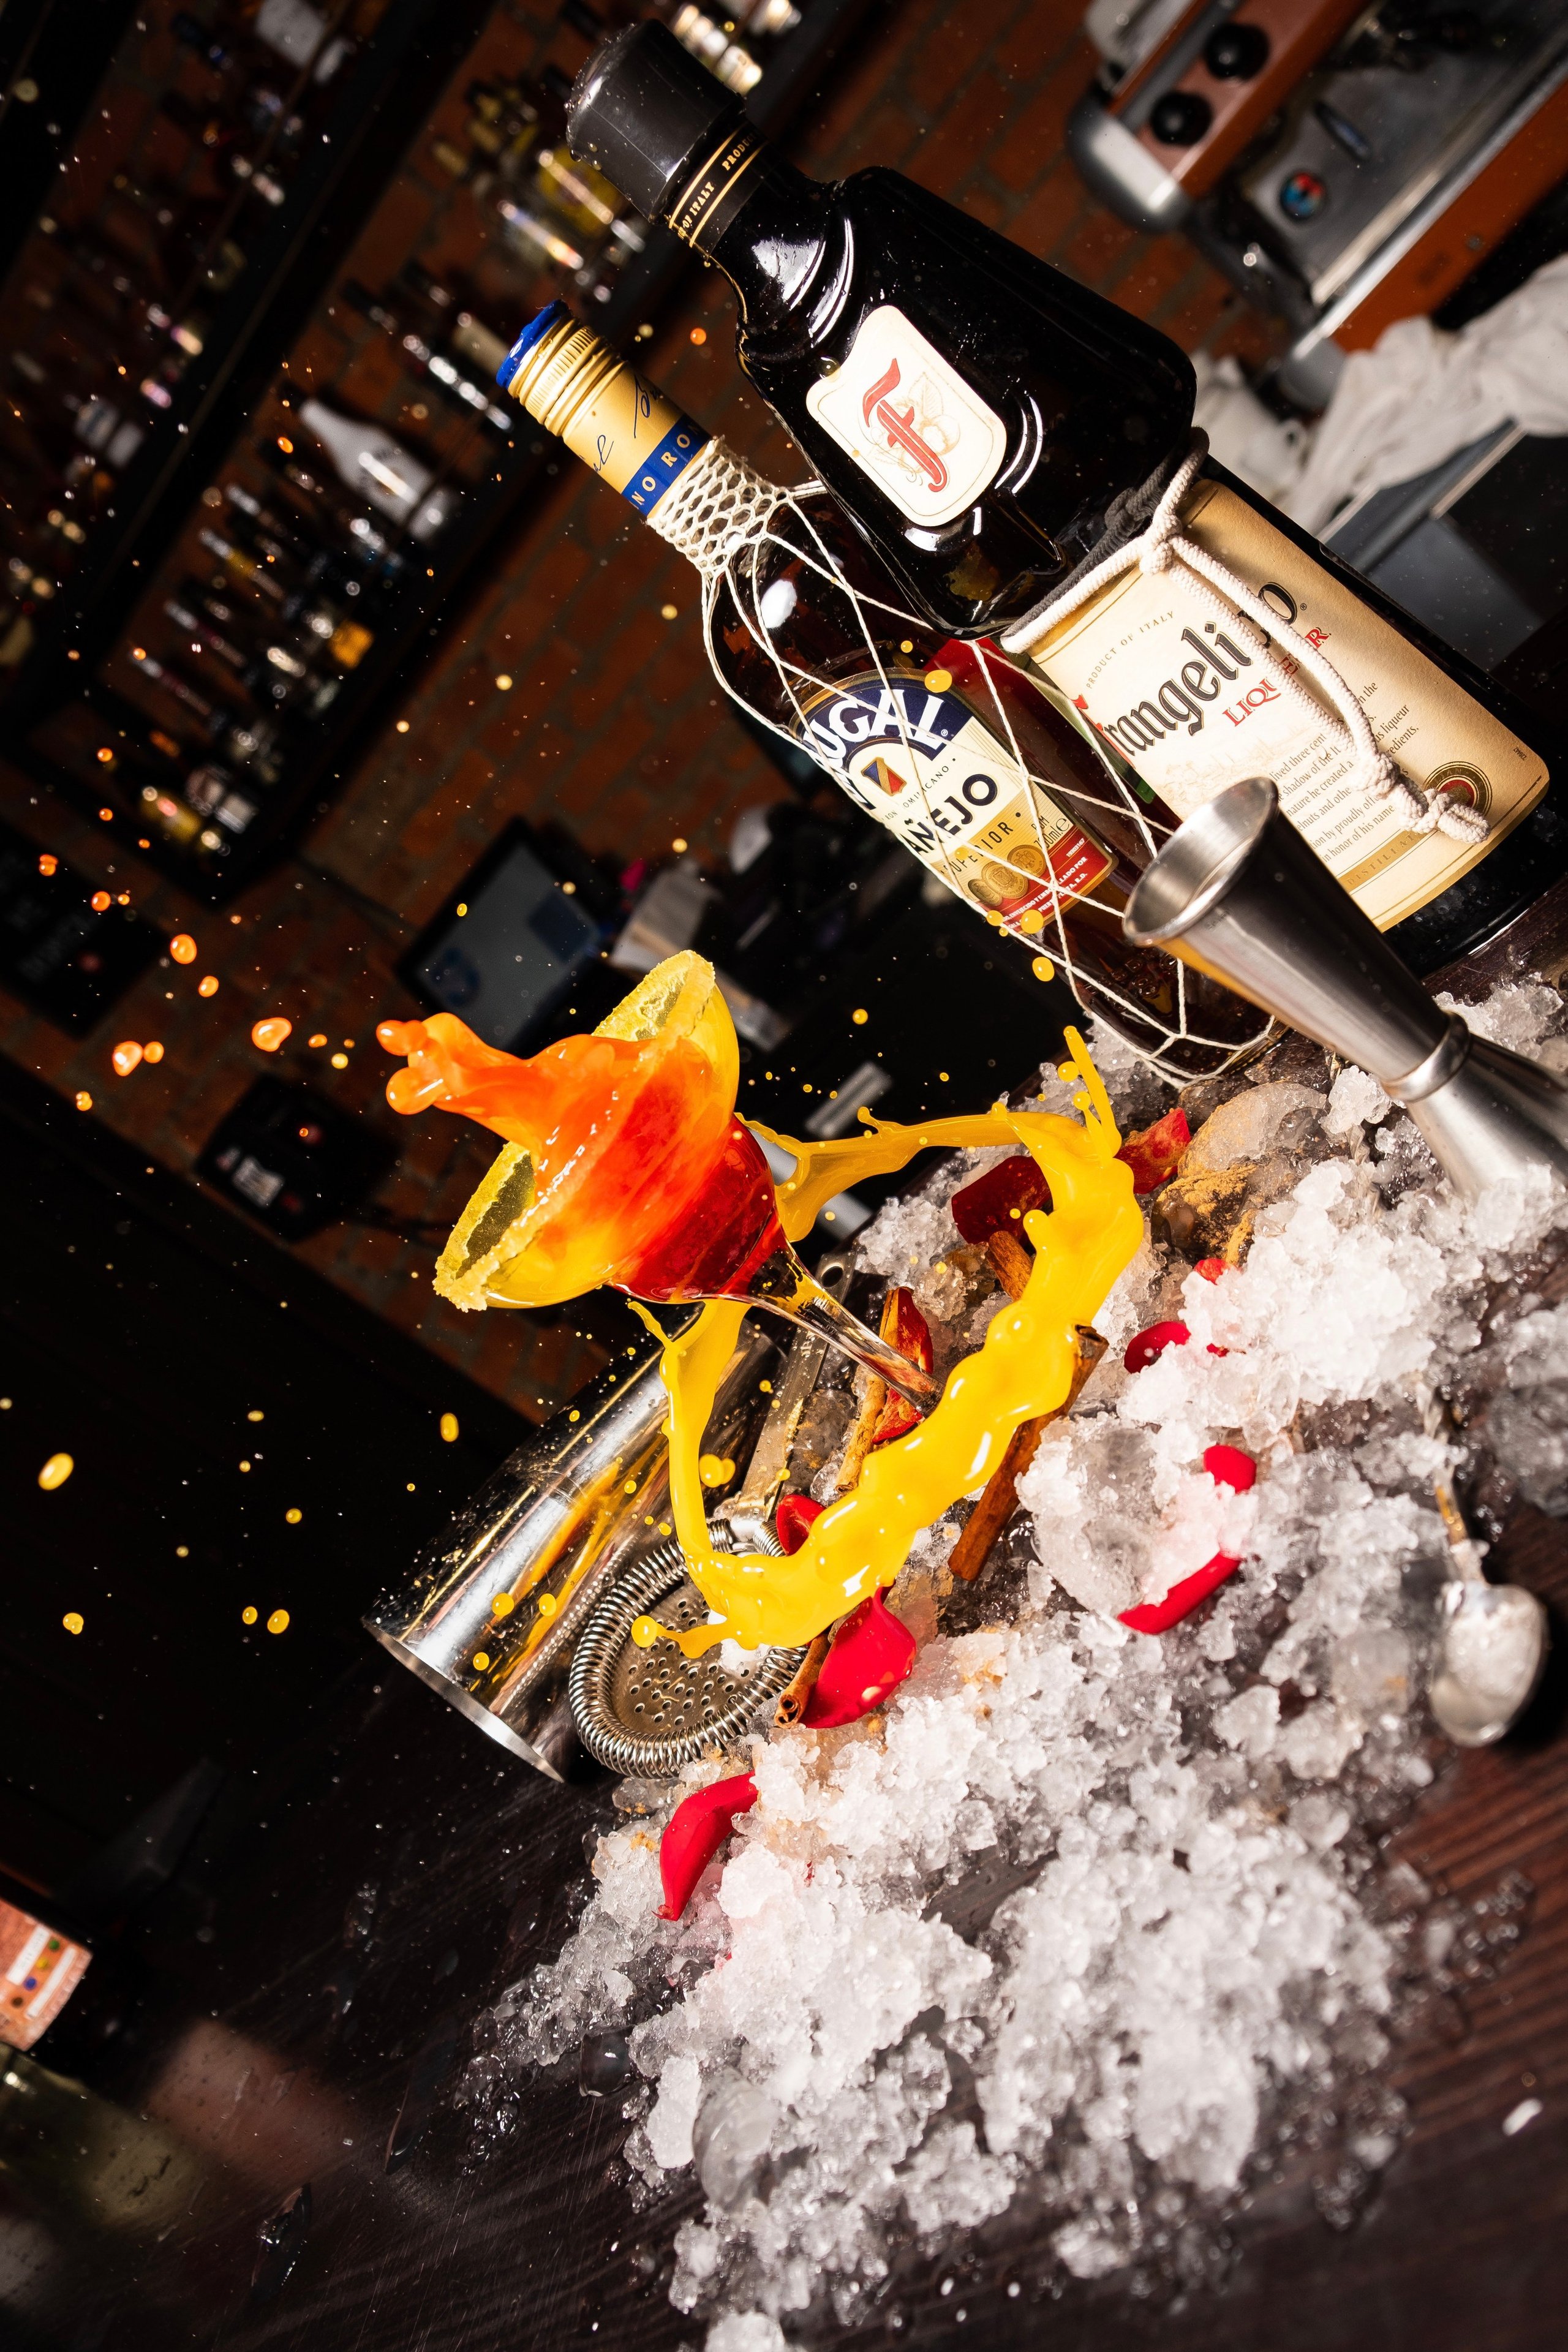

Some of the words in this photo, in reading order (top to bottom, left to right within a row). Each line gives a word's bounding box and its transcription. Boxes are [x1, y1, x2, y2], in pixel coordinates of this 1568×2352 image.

[690, 181, 715, 216] ITALY
[1086, 647, 1117, 689] PRODUCT
[1120, 633, 1133, 646] OF
[1139, 611, 1174, 633] ITALY
[1269, 762, 1292, 782] lived
[1289, 748, 1311, 766] three
[1363, 682, 1378, 697] the
[1283, 772, 1312, 796] shadow
[1311, 760, 1321, 774] of
[1319, 752, 1334, 767] the
[1286, 796, 1311, 817] nature
[1307, 788, 1321, 799] he
[1320, 763, 1348, 791] created
[1380, 704, 1409, 734] liqueur
[900, 774, 998, 854] AÑEJO
[1319, 799, 1335, 815] and
[1322, 829, 1337, 840] by
[1335, 806, 1365, 835] proudly
[1319, 854, 1332, 862] in
[1327, 838, 1352, 858] honor
[1352, 828, 1362, 841] of
[1358, 823, 1374, 834] his
[1373, 805, 1395, 825] name
[1074, 856, 1088, 869] POR
[1075, 872, 1088, 883] R.D.
